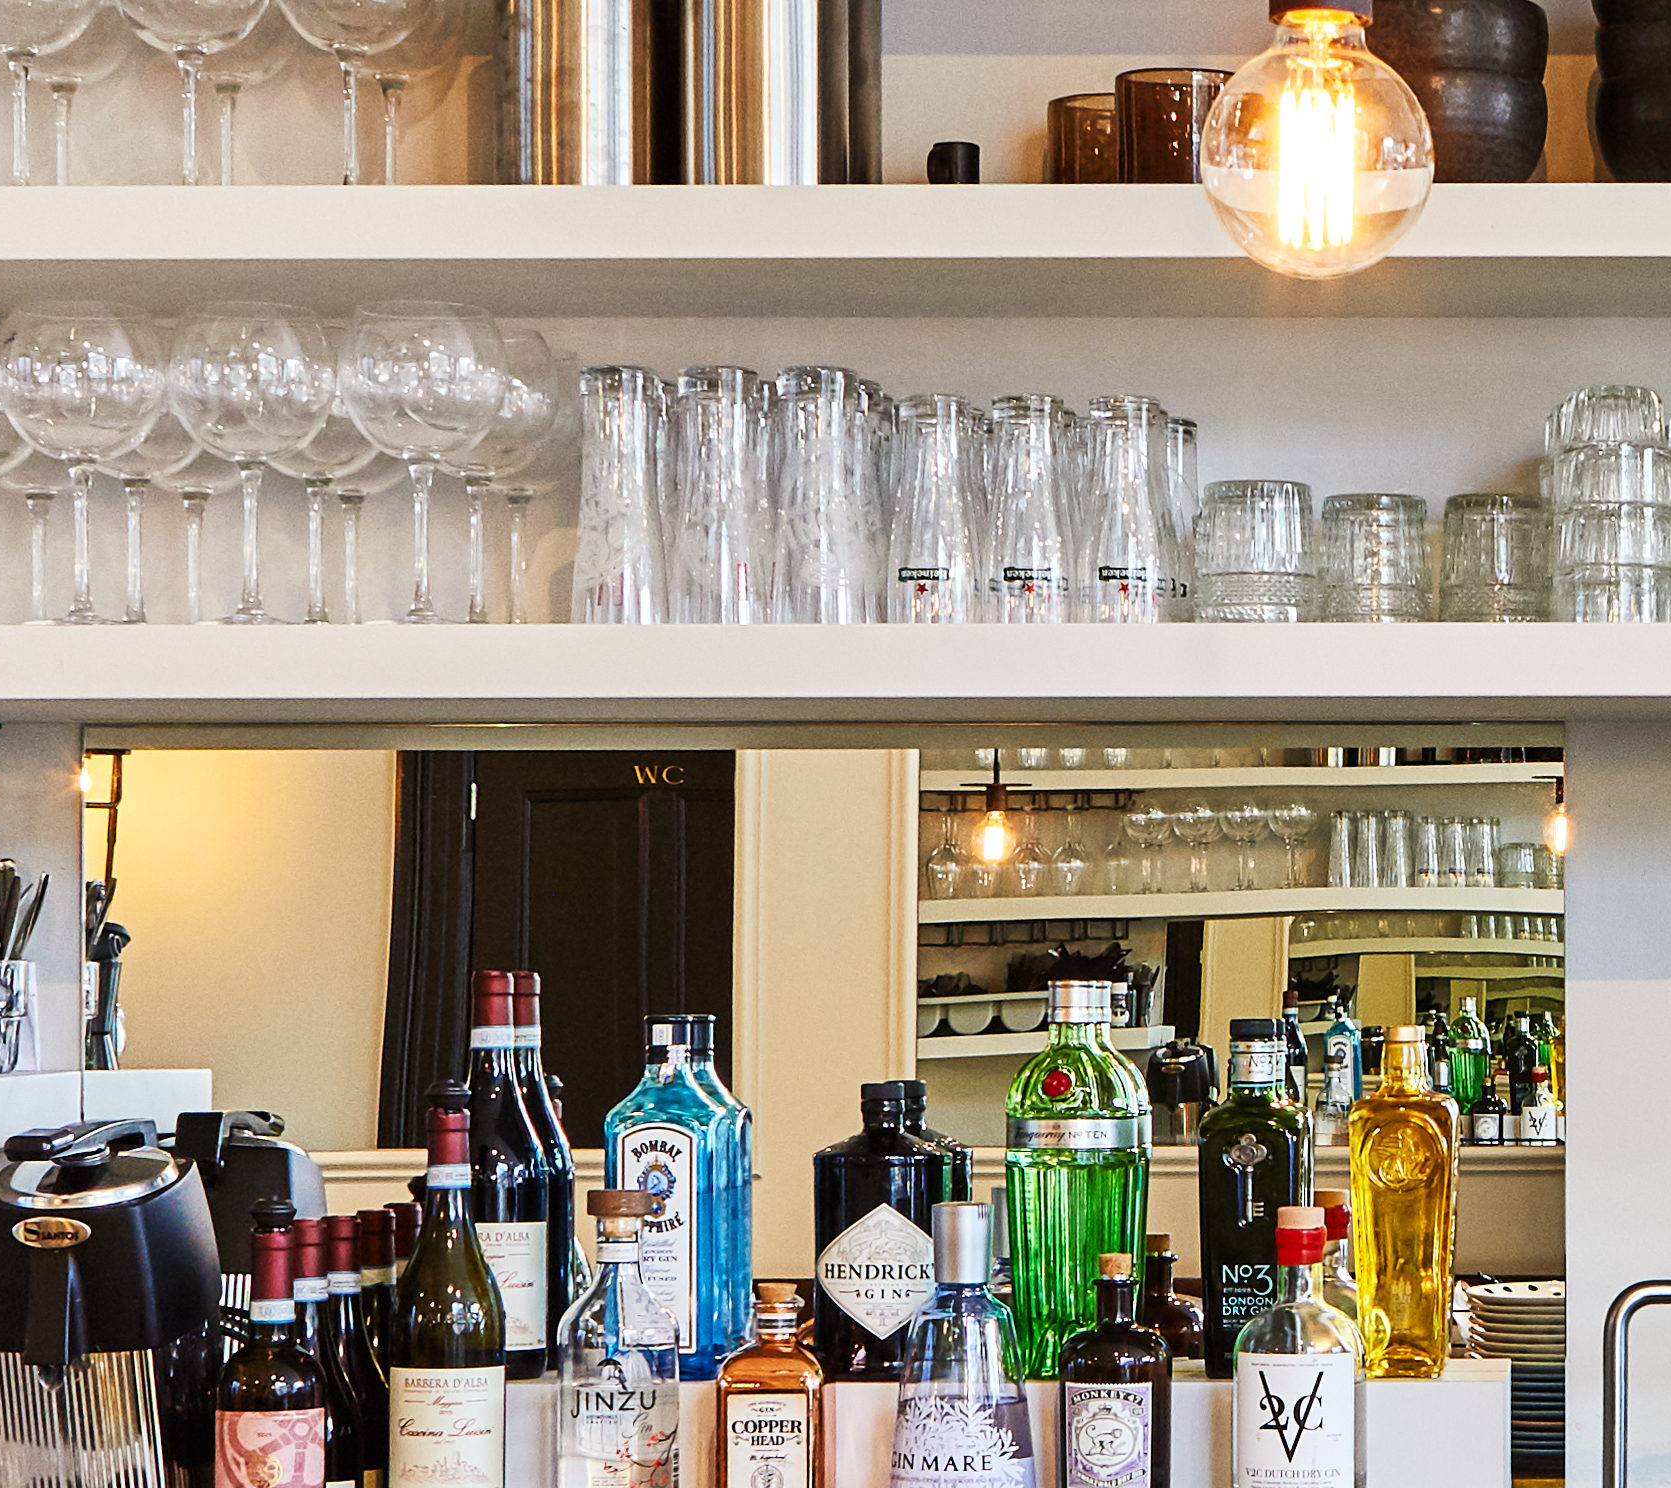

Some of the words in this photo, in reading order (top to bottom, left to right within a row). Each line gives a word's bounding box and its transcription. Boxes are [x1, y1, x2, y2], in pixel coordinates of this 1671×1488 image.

[633, 765, 685, 785] WC
[1085, 1130, 1108, 1139] TEN
[630, 1140, 683, 1162] BOMBAY
[643, 1211, 685, 1234] PPHIRE
[824, 1262, 935, 1281] HENDRICK'
[864, 1289, 903, 1300] GIN
[1222, 1297, 1273, 1306] LONDON
[1222, 1306, 1247, 1316] DRY
[404, 1378, 448, 1389] BARBERA
[570, 1389, 656, 1419] JINZU
[1072, 1390, 1127, 1405] MONKEY
[731, 1419, 802, 1434] COPPER
[751, 1435, 785, 1446] HEAD
[921, 1455, 993, 1472] MARE
[1264, 1468, 1300, 1479] DUTCH
[1302, 1468, 1323, 1479] DRY
